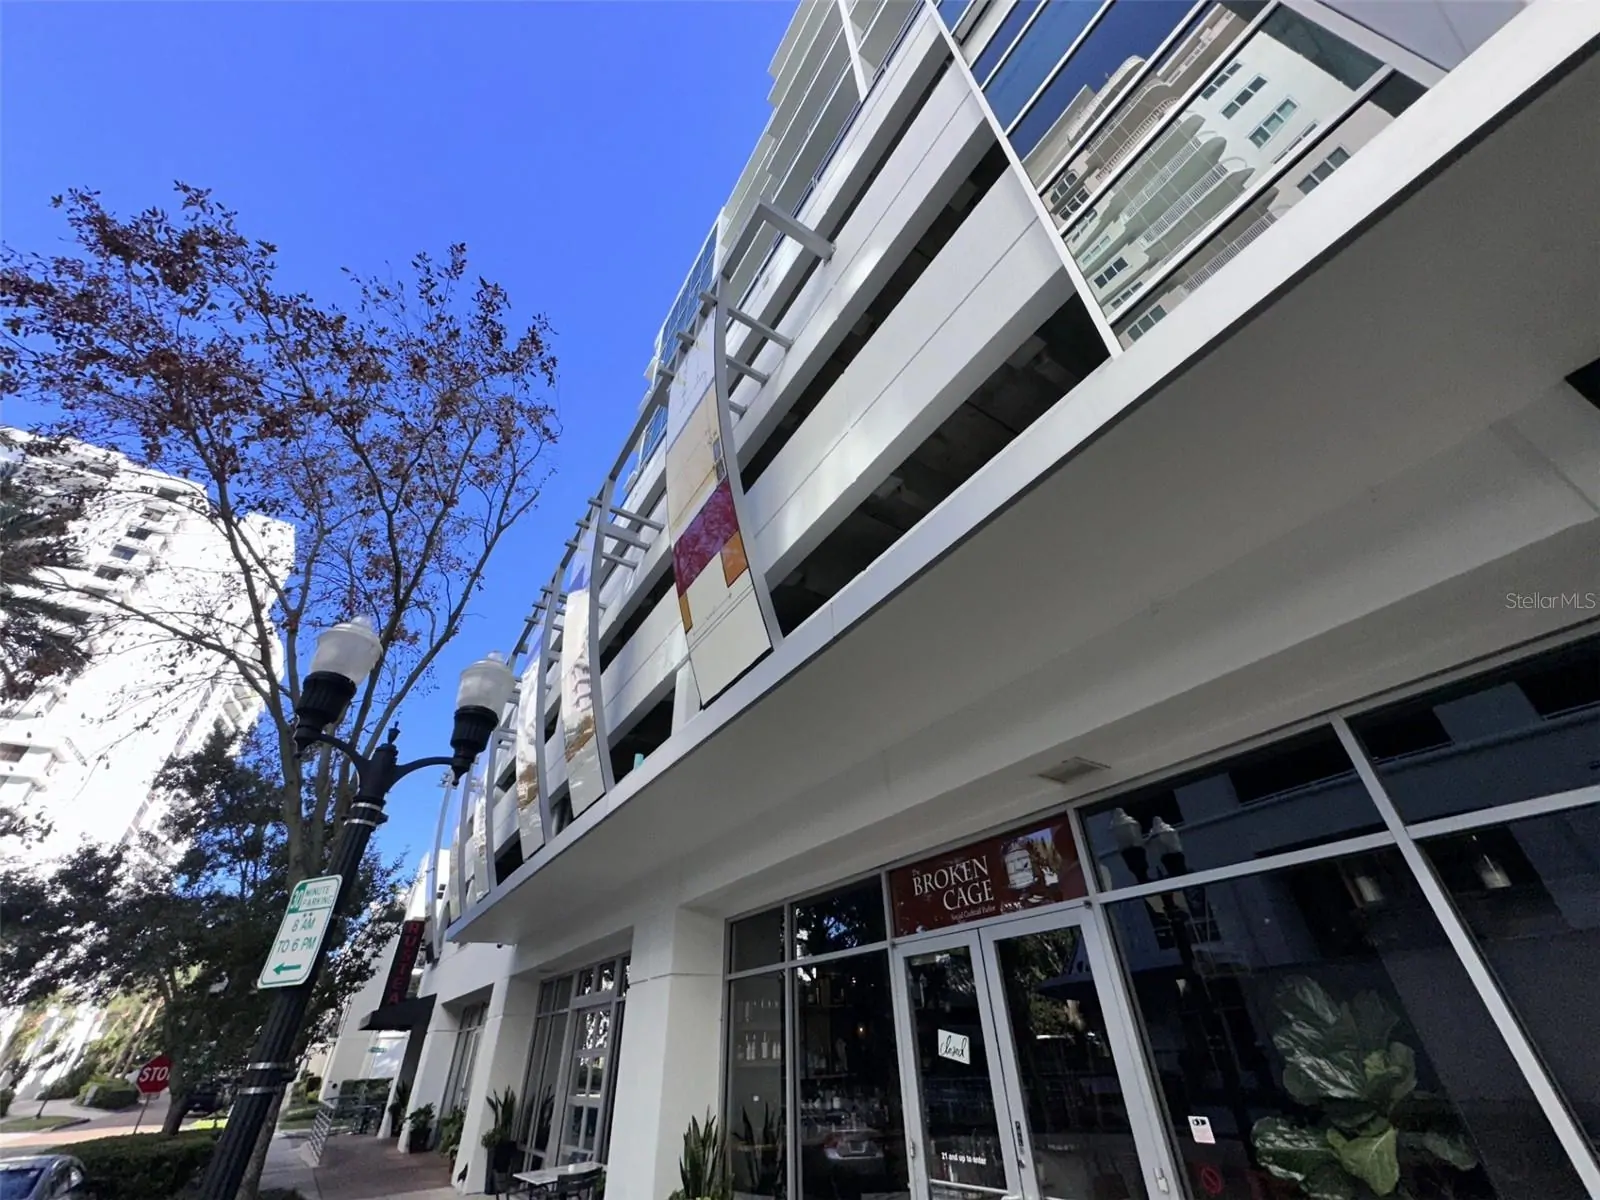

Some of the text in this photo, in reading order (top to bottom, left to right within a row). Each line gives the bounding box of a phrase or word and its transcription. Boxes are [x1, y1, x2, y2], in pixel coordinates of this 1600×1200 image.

[912, 855, 989, 897] BROKEN
[305, 885, 332, 897] MINUTE
[943, 878, 995, 911] CAGE
[302, 894, 335, 906] PARKING
[300, 917, 316, 931] AM
[278, 936, 317, 953] TO 6 PM
[949, 1153, 958, 1161] and
[959, 1155, 966, 1164] up
[966, 1155, 972, 1163] to
[973, 1156, 986, 1165] enter
